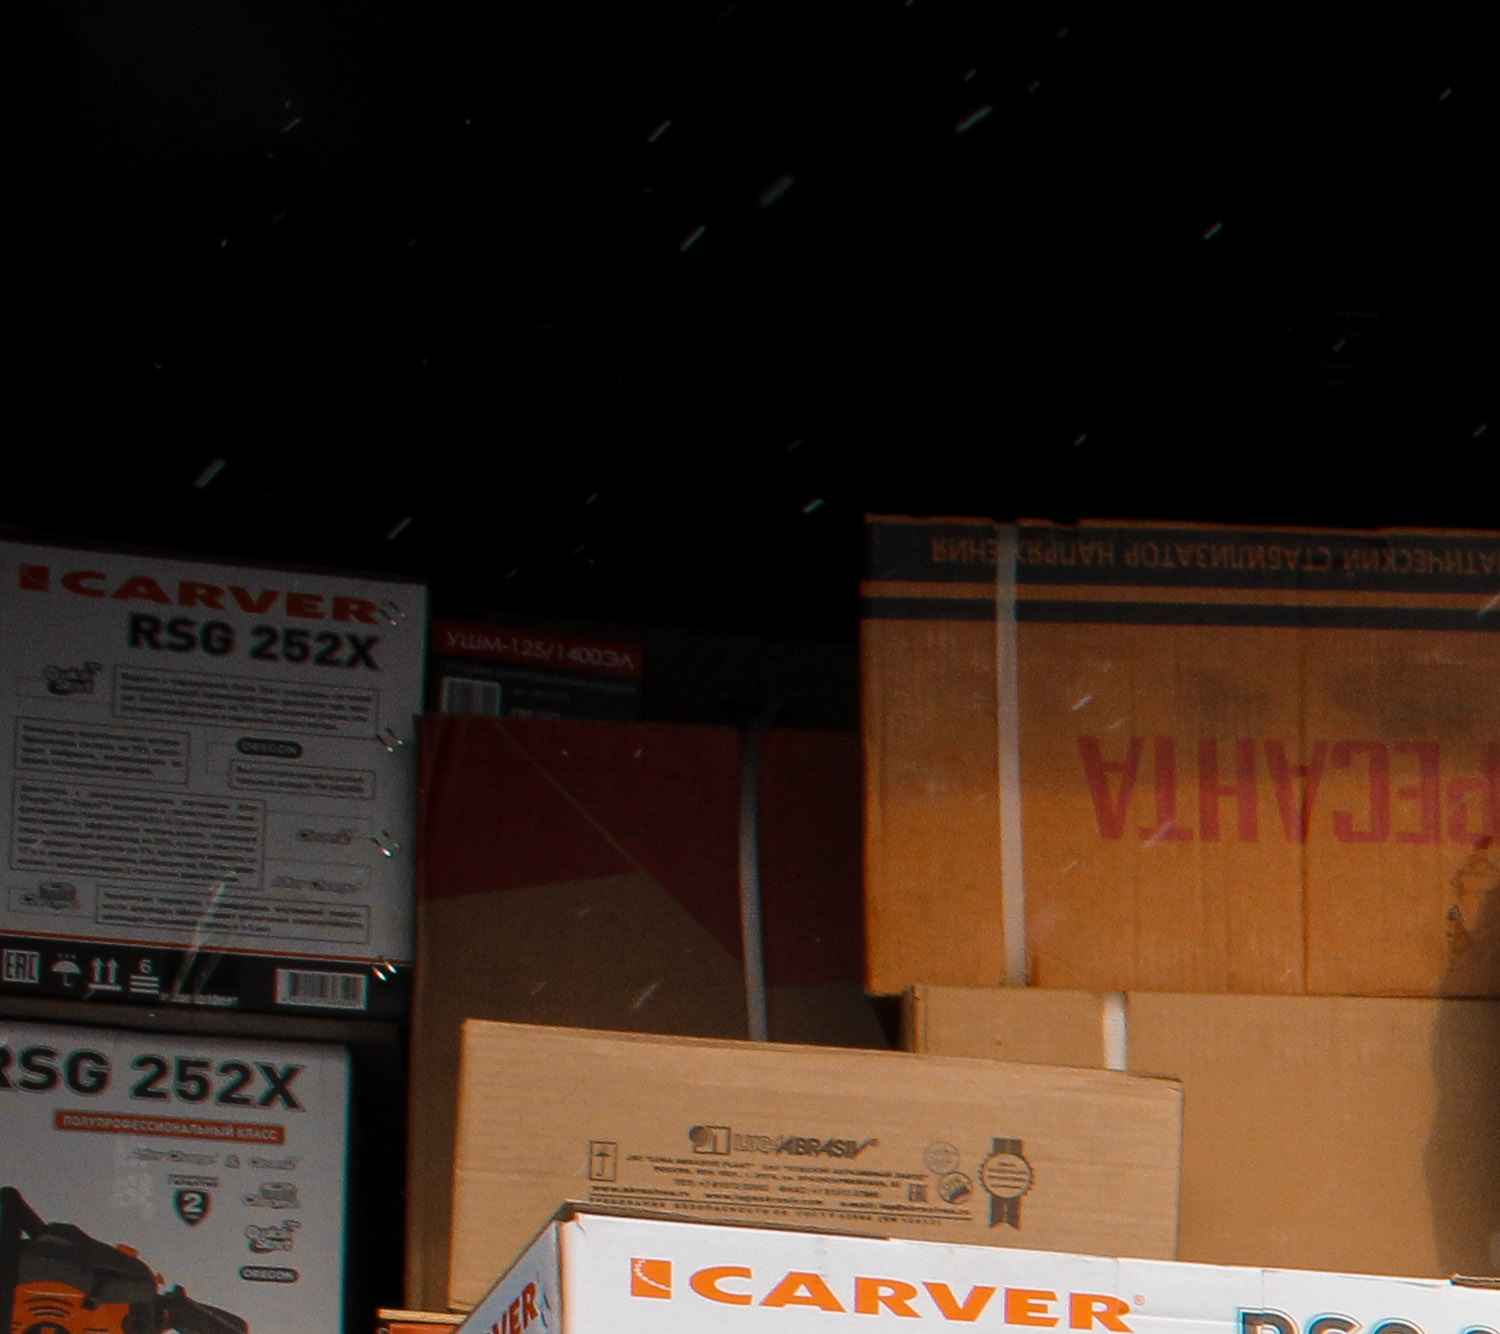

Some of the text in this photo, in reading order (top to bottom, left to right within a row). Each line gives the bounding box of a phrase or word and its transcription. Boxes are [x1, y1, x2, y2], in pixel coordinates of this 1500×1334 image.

[929, 534, 1116, 567] НАПРЯЕНИЯ
[1124, 541, 1335, 573] СТАБИЛИЗАТОР
[61, 571, 380, 624] CARVER
[128, 611, 381, 672] RSG 252X
[130, 1054, 307, 1113] 252X
[238, 1125, 277, 1141] КЛАСС
[690, 1265, 1136, 1333] CARVER
